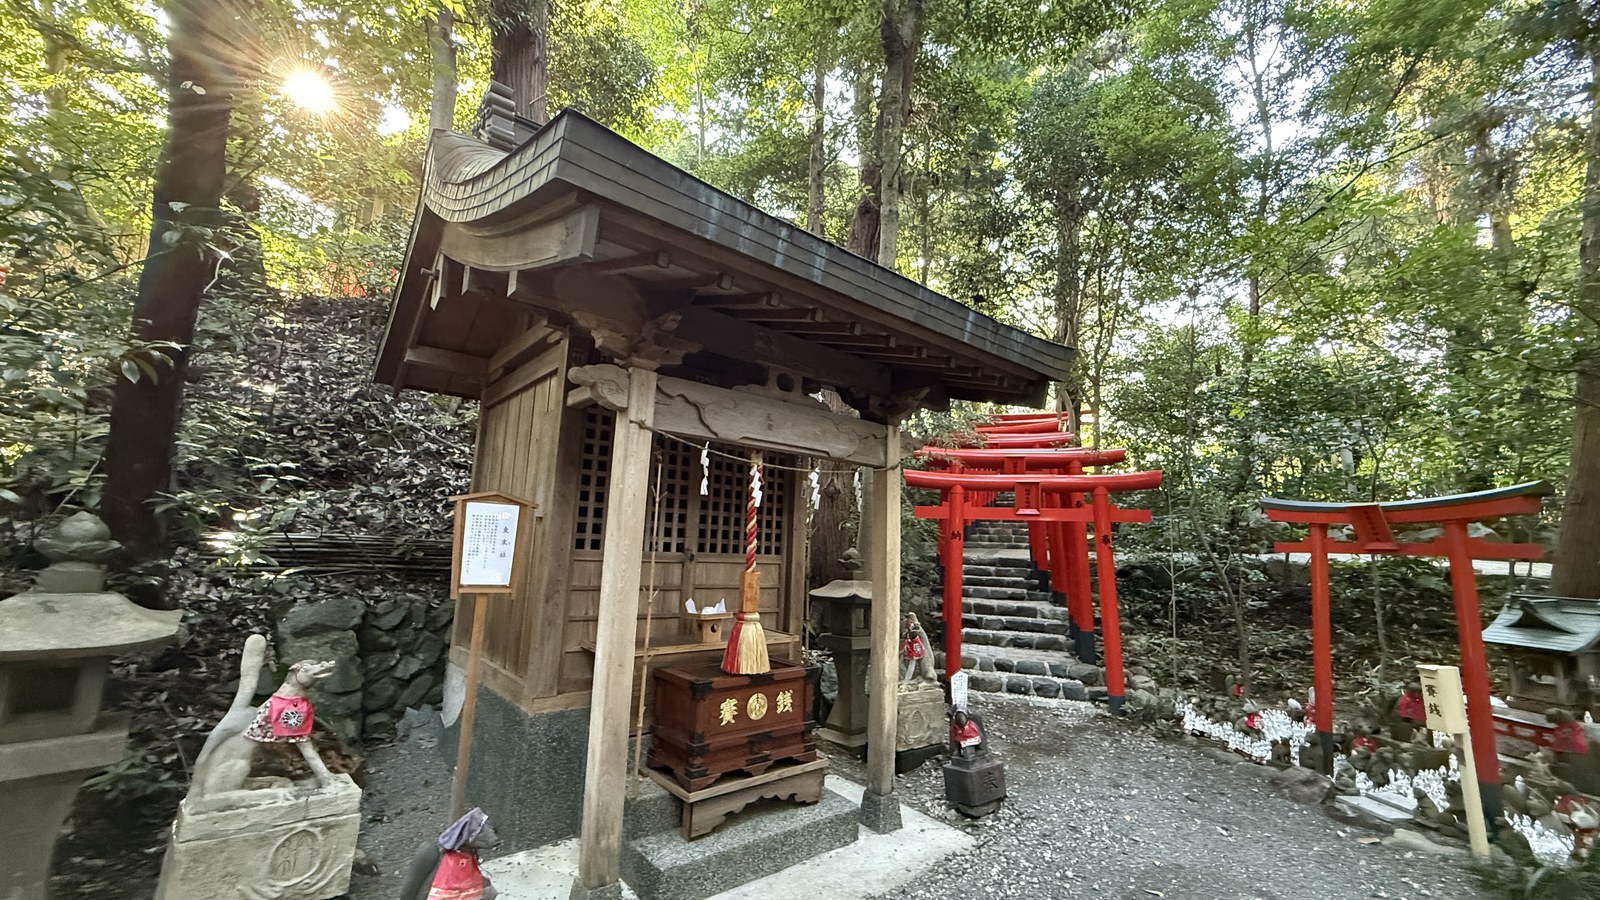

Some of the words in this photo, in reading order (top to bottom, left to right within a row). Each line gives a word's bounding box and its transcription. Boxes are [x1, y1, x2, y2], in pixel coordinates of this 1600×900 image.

[950, 530, 962, 541] 納
[1100, 534, 1111, 546] 奉
[718, 698, 739, 727] 賽
